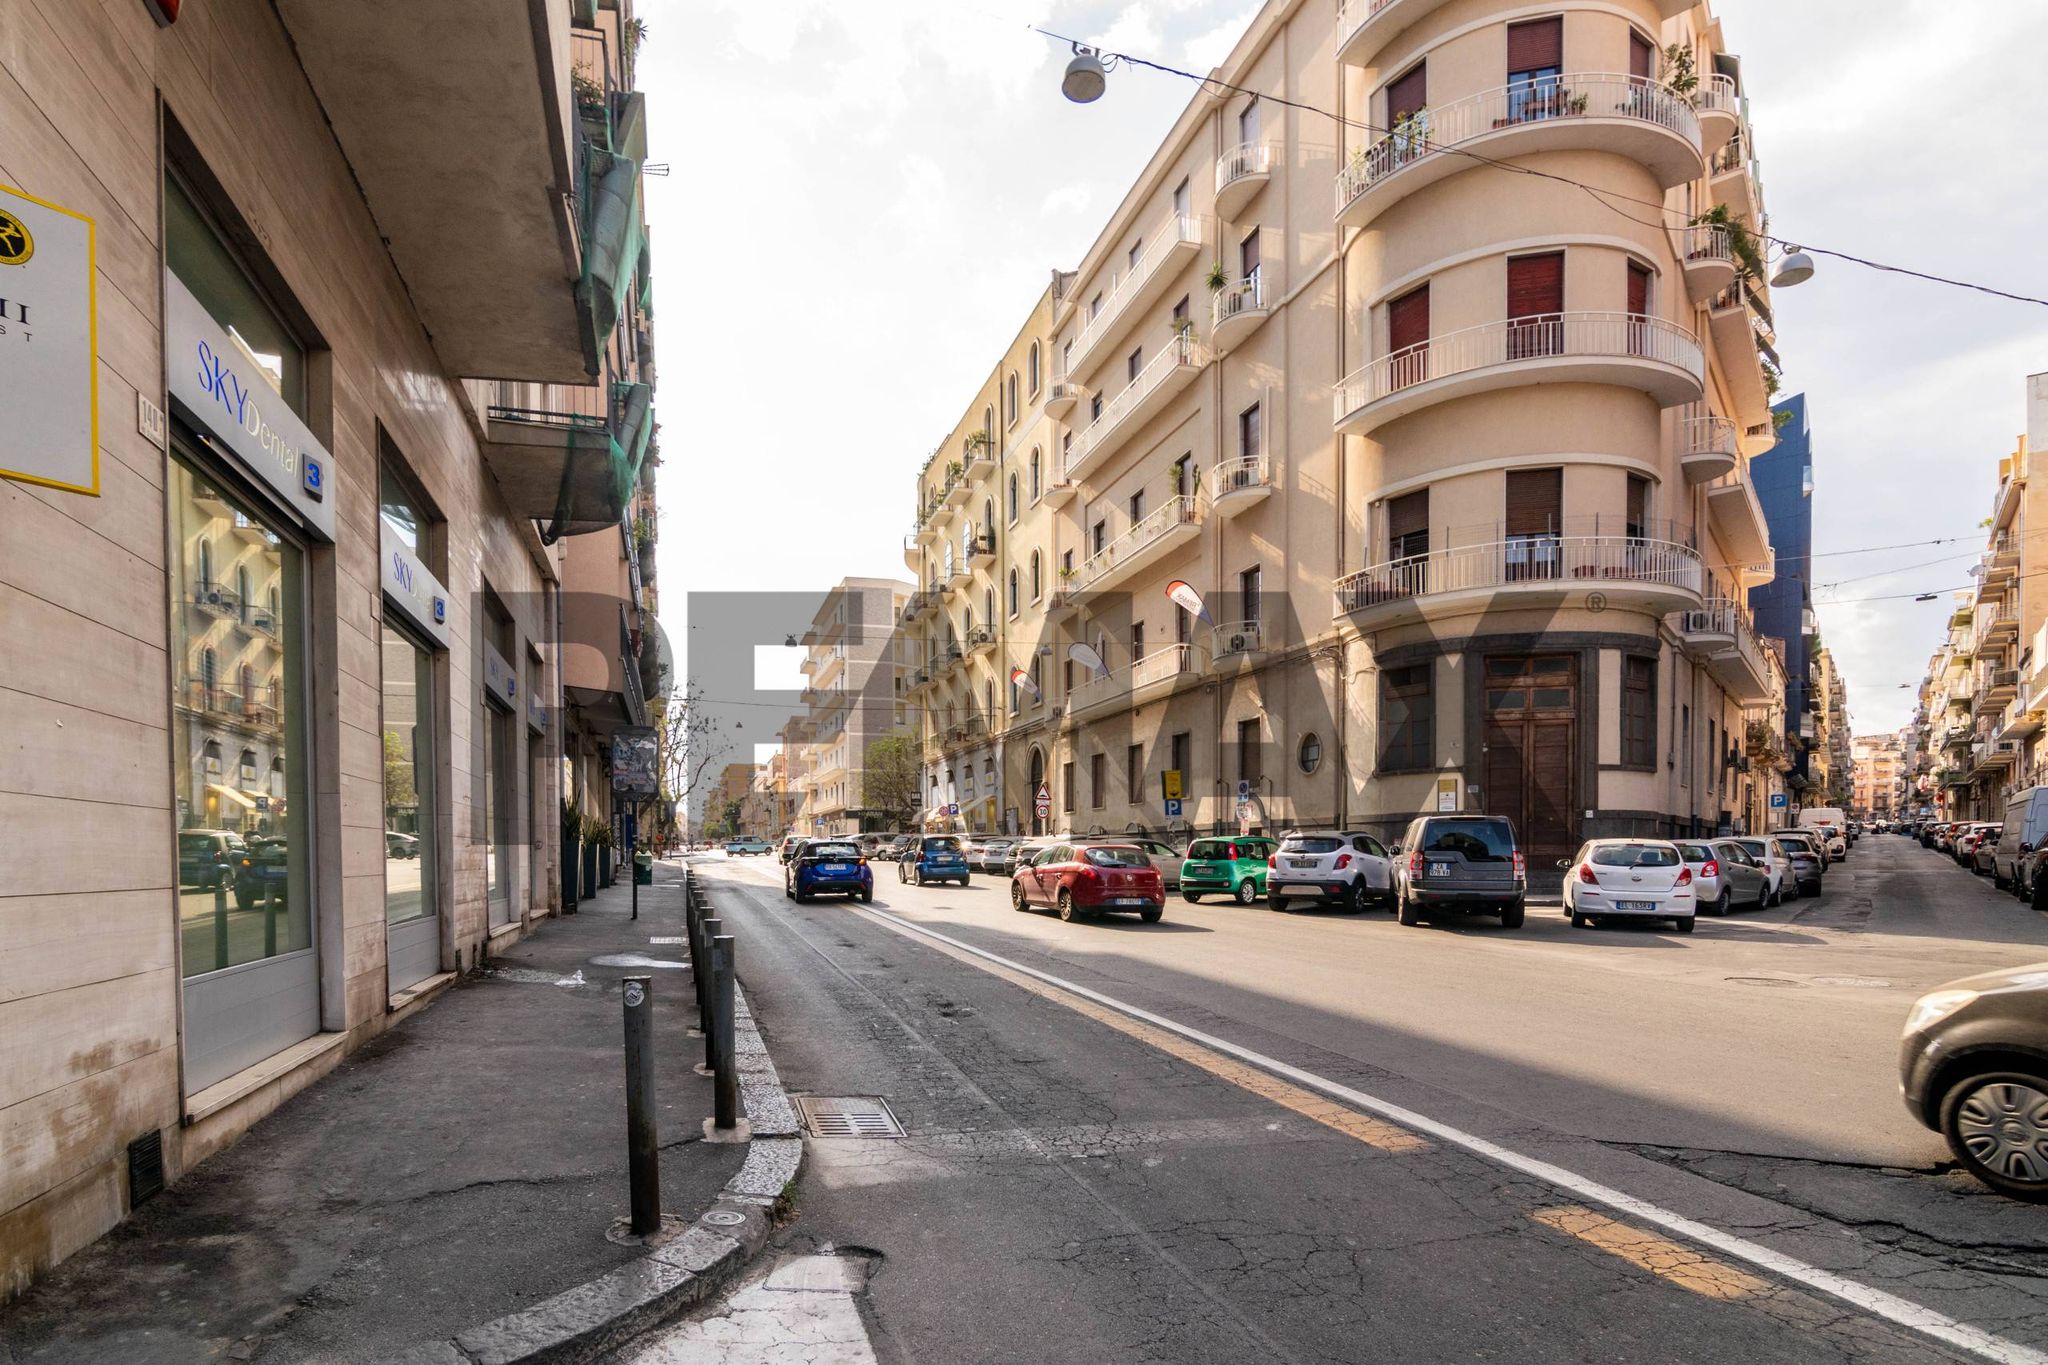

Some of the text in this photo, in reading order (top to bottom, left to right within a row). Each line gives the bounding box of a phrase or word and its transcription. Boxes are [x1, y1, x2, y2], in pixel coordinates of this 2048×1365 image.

[307, 463, 321, 488] 3
[436, 600, 445, 617] 3
[1168, 801, 1178, 816] P
[1773, 796, 1783, 806] P
[950, 805, 957, 814] P
